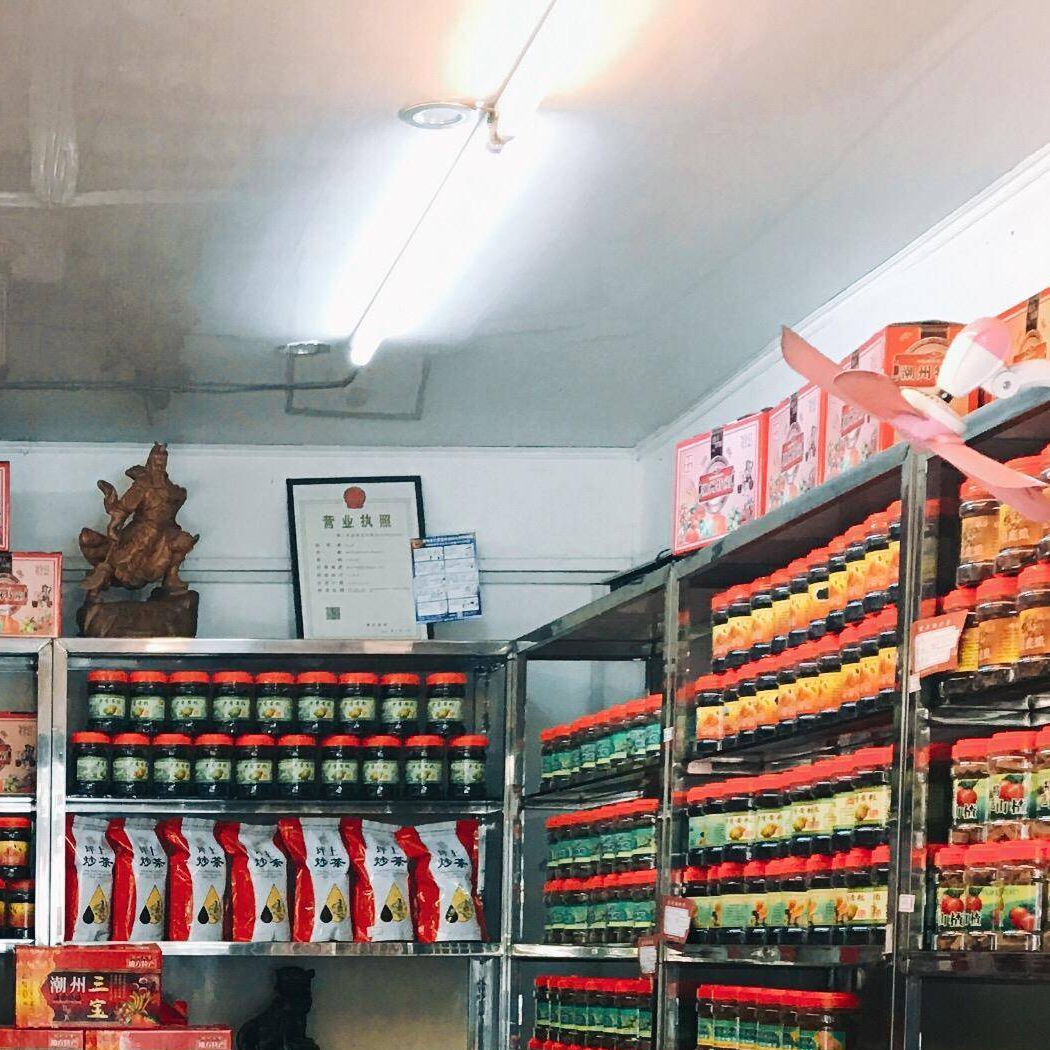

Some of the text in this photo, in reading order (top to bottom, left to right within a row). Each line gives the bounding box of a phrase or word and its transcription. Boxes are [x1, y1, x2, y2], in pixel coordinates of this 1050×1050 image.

[323, 514, 392, 529] 营业执照
[83, 856, 113, 867] 炒茶
[140, 857, 165, 868] 炒茶
[196, 856, 224, 868] 炒茶
[314, 857, 346, 868] 炒茶
[373, 856, 408, 867] 炒茶
[437, 857, 469, 868] 炒茶
[50, 976, 86, 993] 潮州
